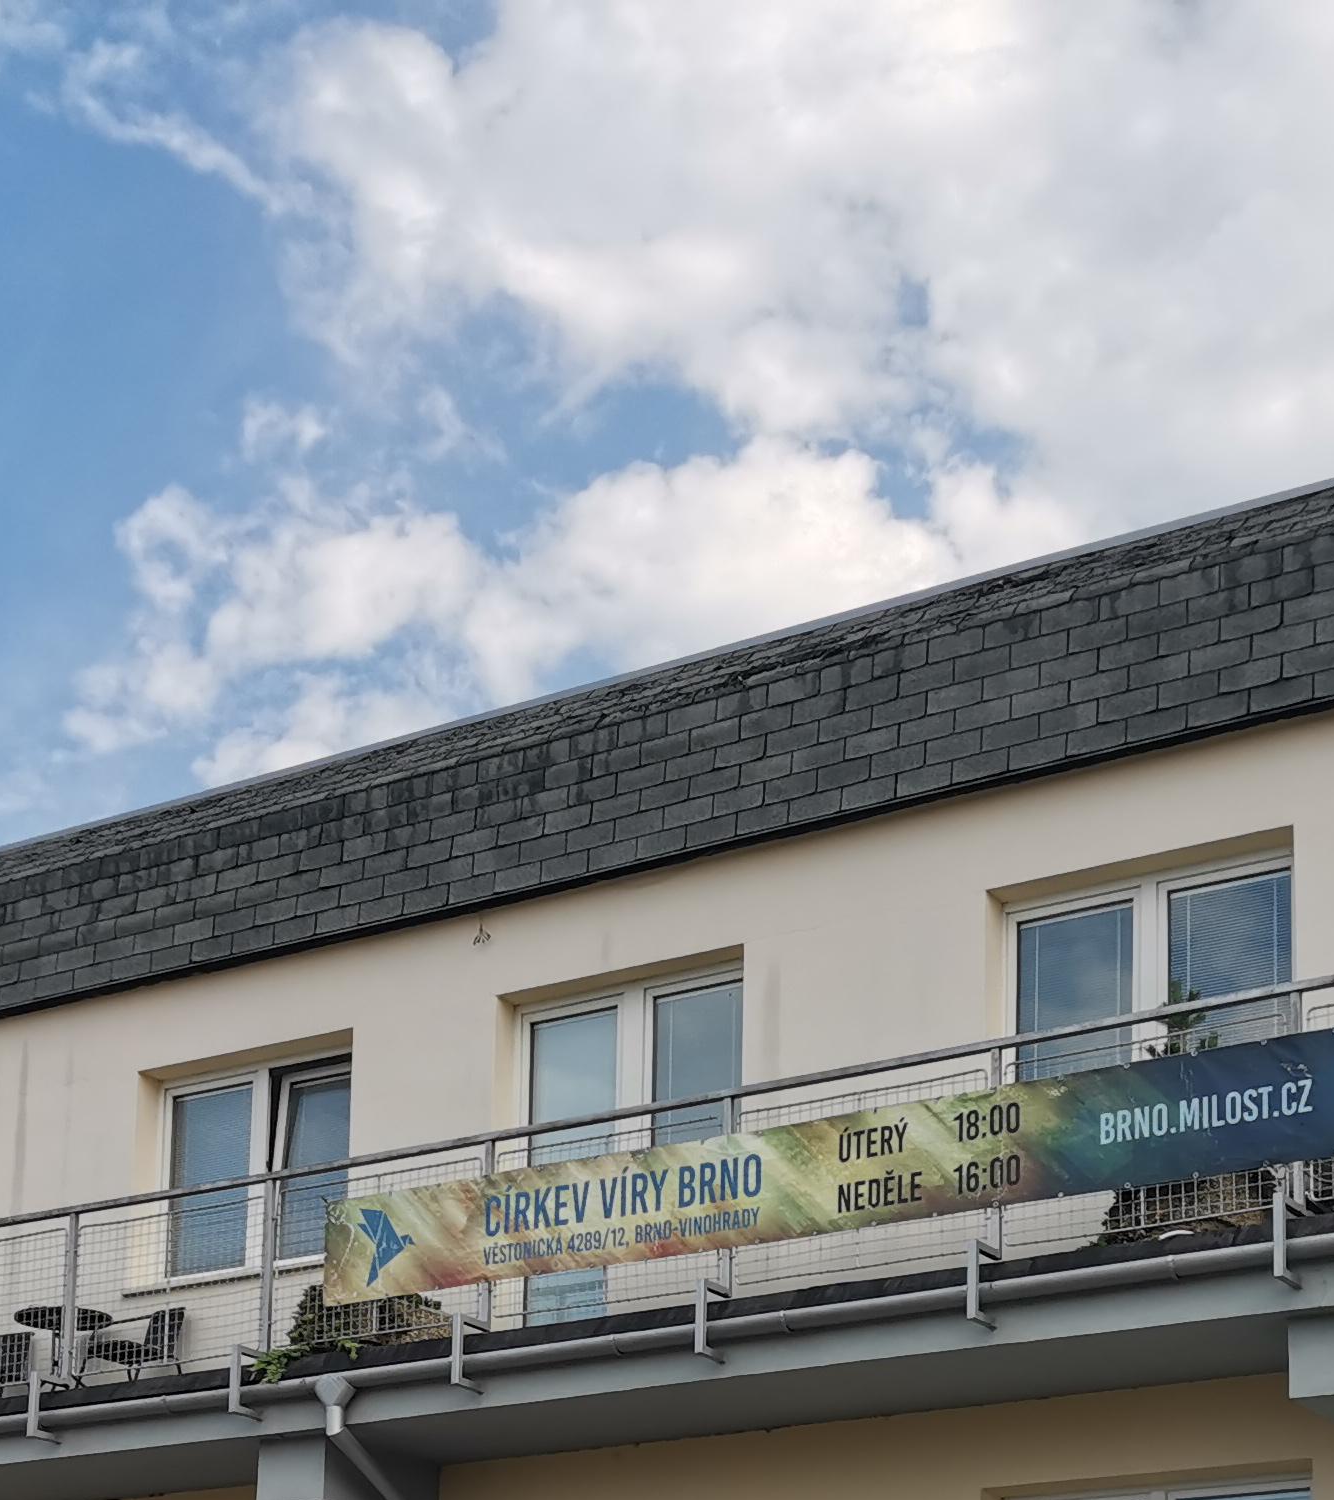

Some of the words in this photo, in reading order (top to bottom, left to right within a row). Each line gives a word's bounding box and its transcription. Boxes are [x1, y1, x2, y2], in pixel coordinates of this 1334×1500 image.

[838, 1116, 908, 1163] ÚTERÝ
[953, 1102, 1020, 1143] 18:00
[1099, 1078, 1313, 1145] BRNO.MILOST.CZ
[484, 1180, 590, 1237] CÍRKEV
[600, 1166, 669, 1219] VÍRY
[678, 1153, 762, 1209] BRNO
[837, 1168, 923, 1214] NEDĚLE
[953, 1154, 1021, 1195] 16:00
[483, 1236, 564, 1266] VĚSTONICKÁ
[568, 1226, 630, 1252] 4289/12,
[635, 1206, 760, 1243] BRNO-VINOHRADY
